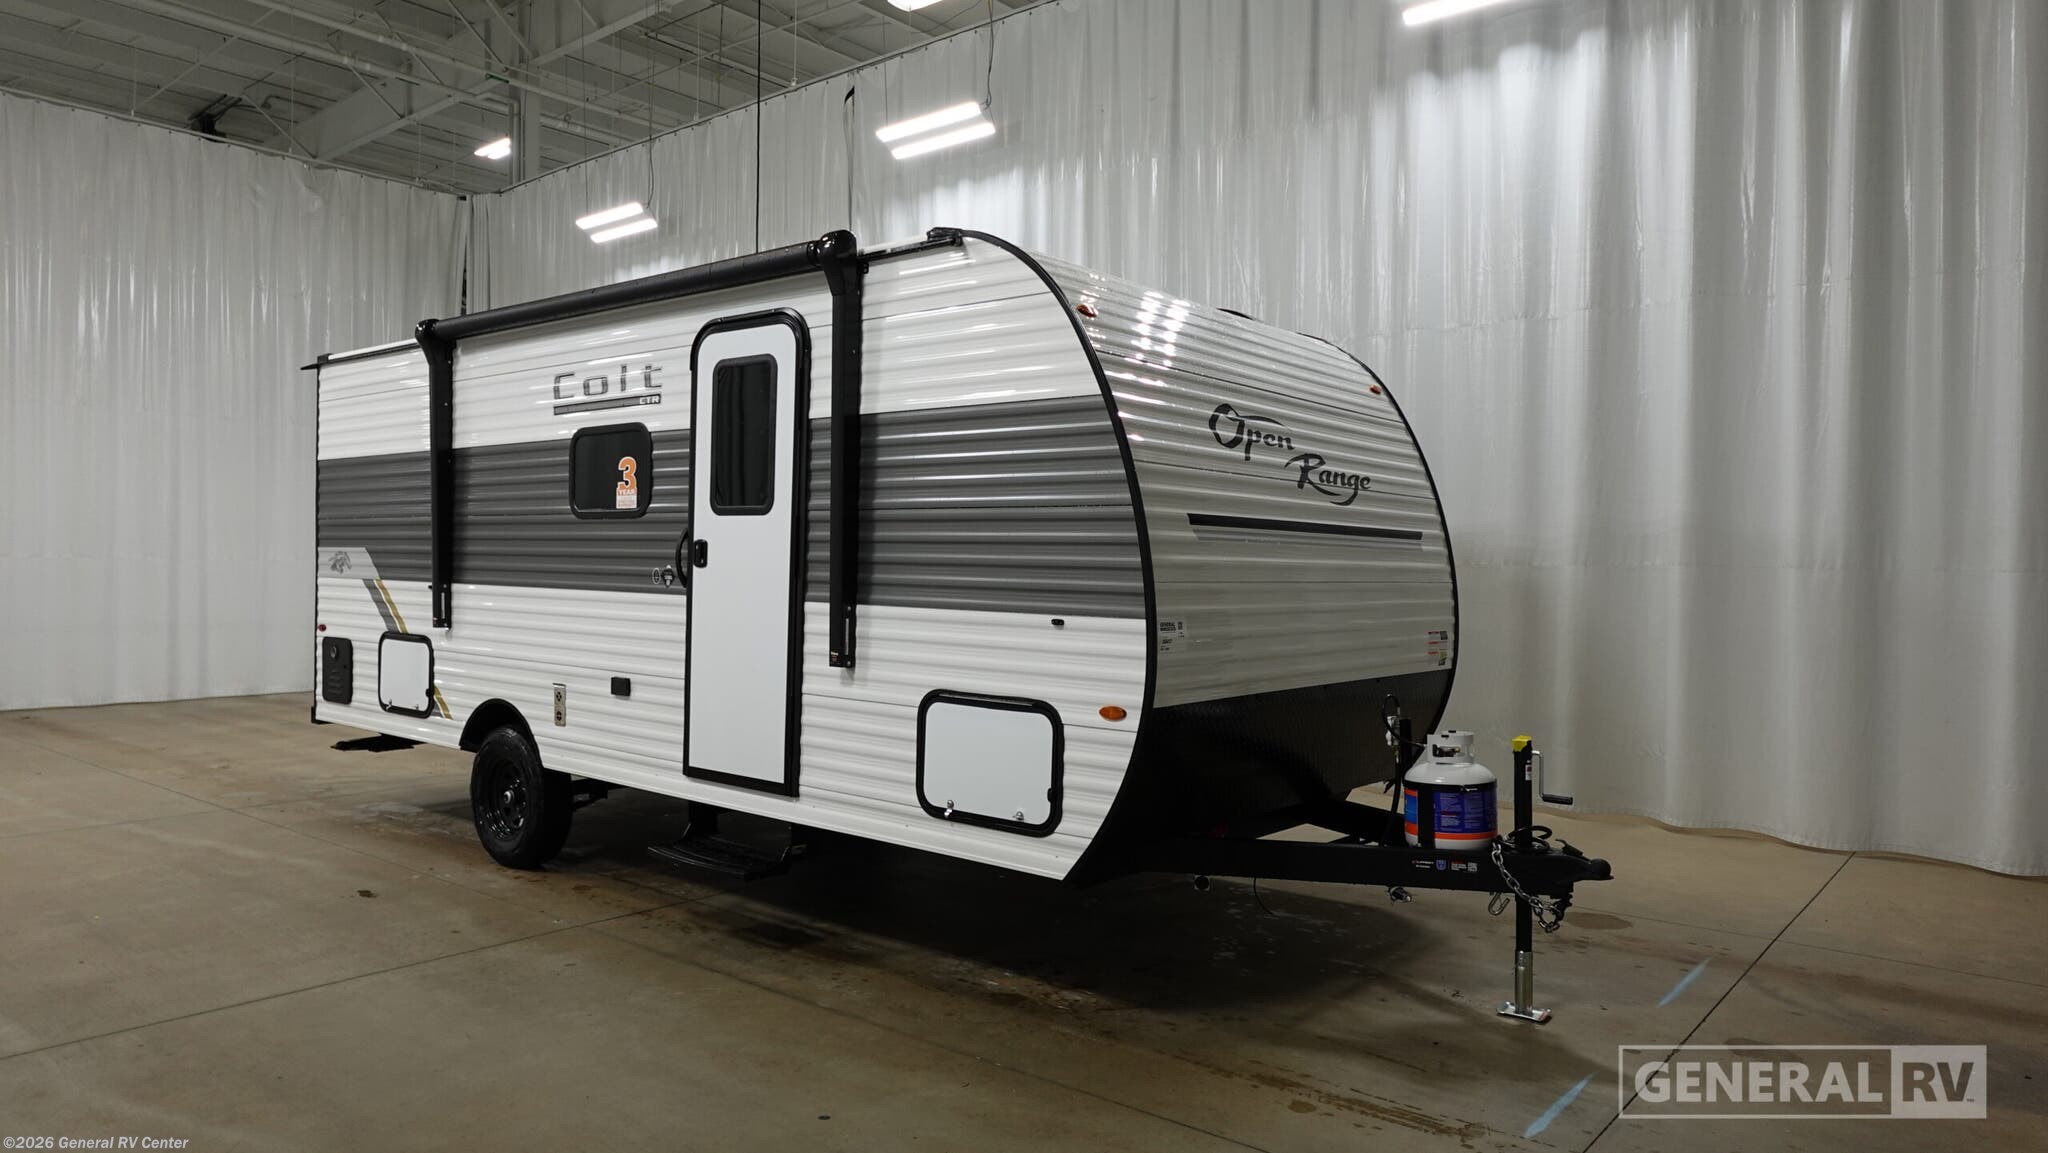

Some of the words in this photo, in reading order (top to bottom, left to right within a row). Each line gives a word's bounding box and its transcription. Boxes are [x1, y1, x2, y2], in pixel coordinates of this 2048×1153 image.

[553, 364, 662, 400] Colt
[1208, 403, 1296, 462] Open
[617, 456, 637, 490] 3
[1284, 453, 1371, 506] Range
